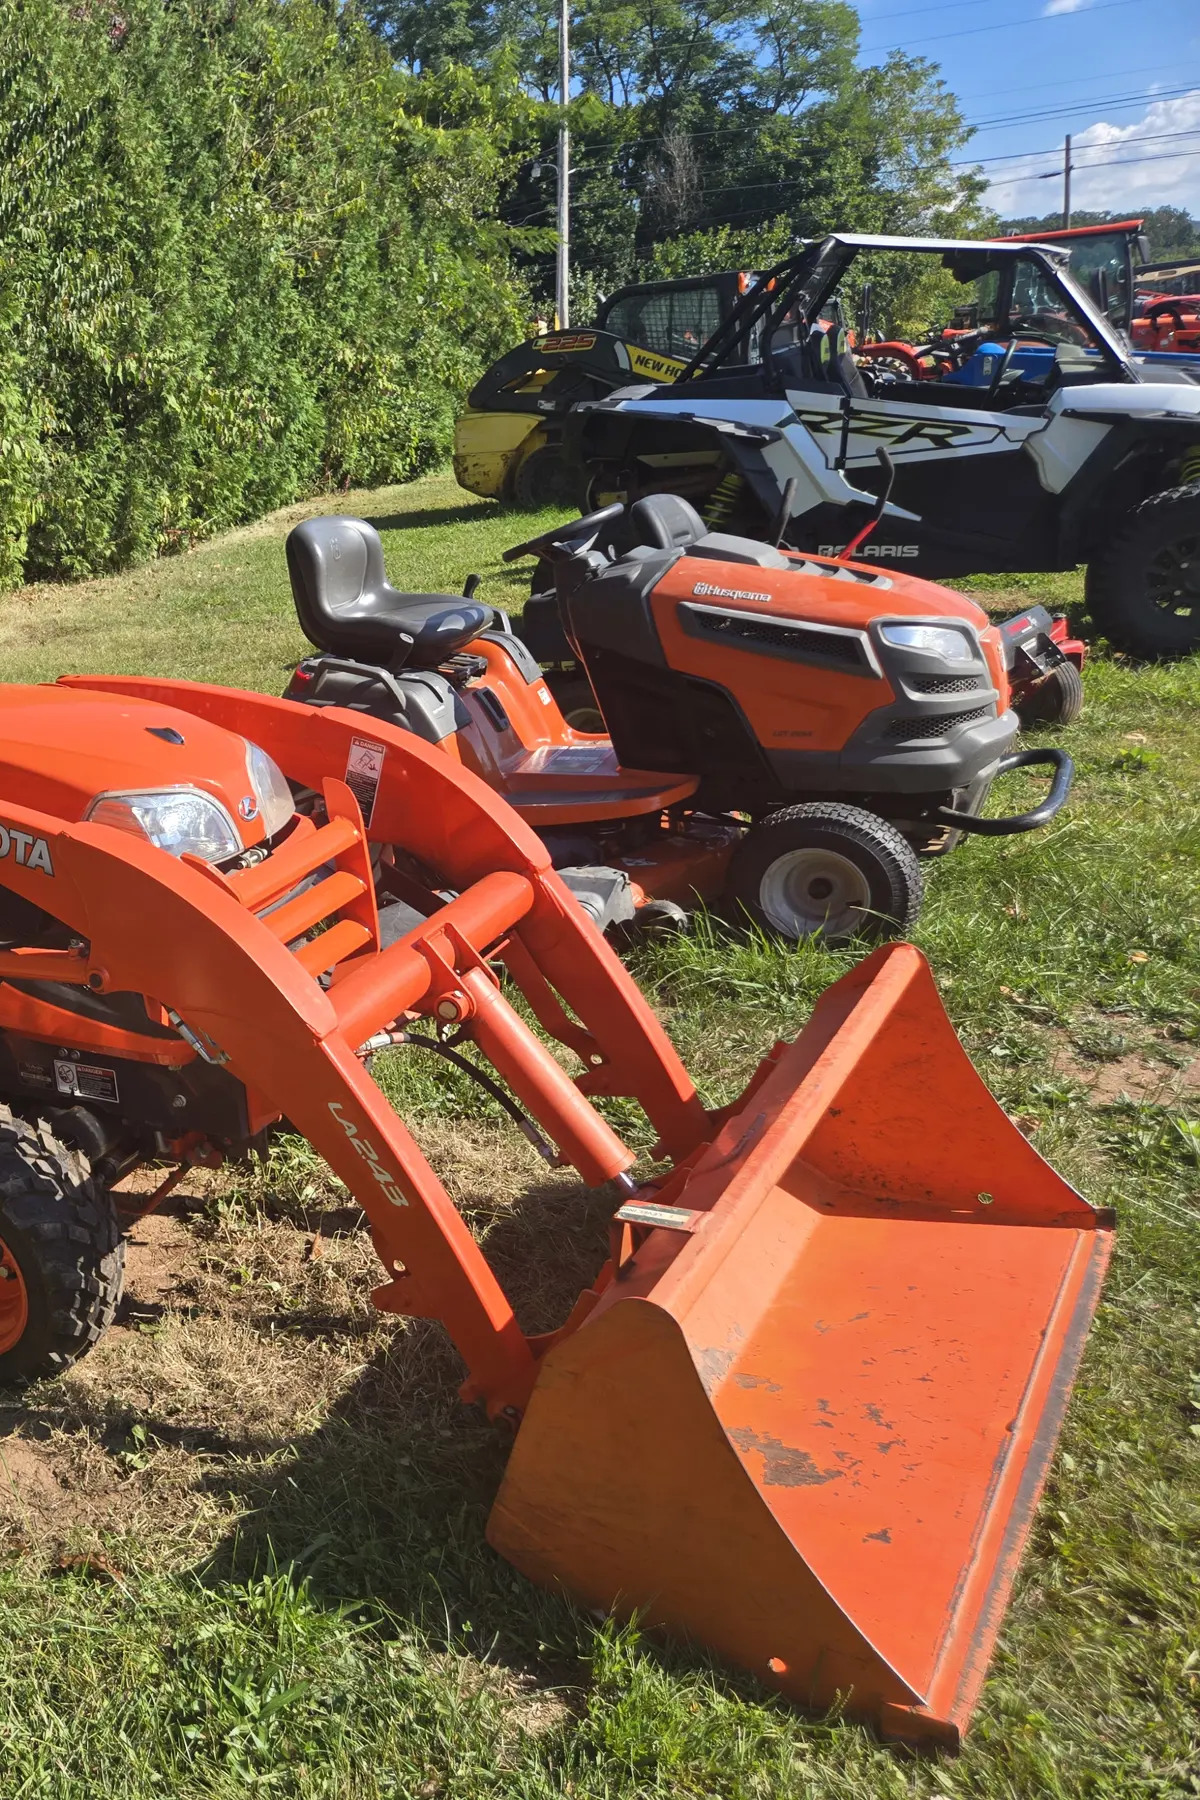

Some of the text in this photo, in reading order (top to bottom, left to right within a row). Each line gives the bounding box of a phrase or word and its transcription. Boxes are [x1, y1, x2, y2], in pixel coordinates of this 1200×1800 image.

[532, 334, 596, 353] L225
[634, 354, 664, 373] NEW
[775, 409, 972, 449] RZR
[706, 585, 772, 602] Husqvarna
[360, 742, 383, 753] DANGER
[81, 1067, 103, 1075] DANGER
[328, 1102, 409, 1207] LA243
